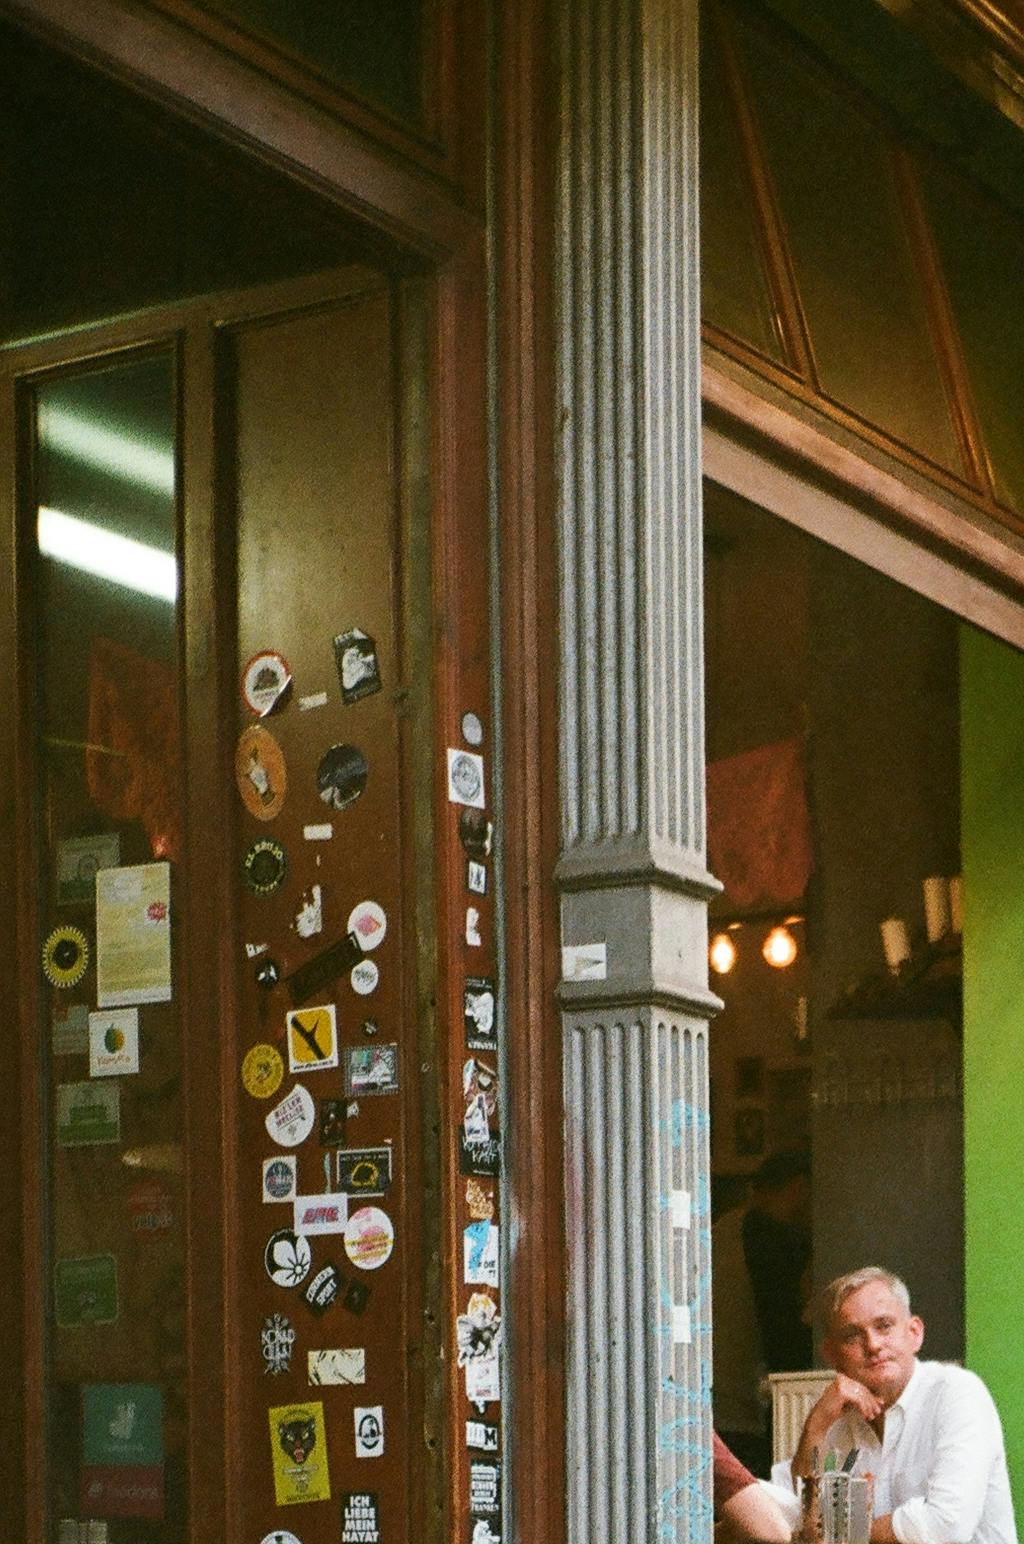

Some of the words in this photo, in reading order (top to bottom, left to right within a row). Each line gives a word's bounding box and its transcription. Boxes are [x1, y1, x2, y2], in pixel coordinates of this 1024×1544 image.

[349, 1495, 371, 1508] ICH
[344, 1507, 376, 1519] LIEBE
[344, 1519, 376, 1531] MEIN
[342, 1531, 380, 1543] HAYAT
